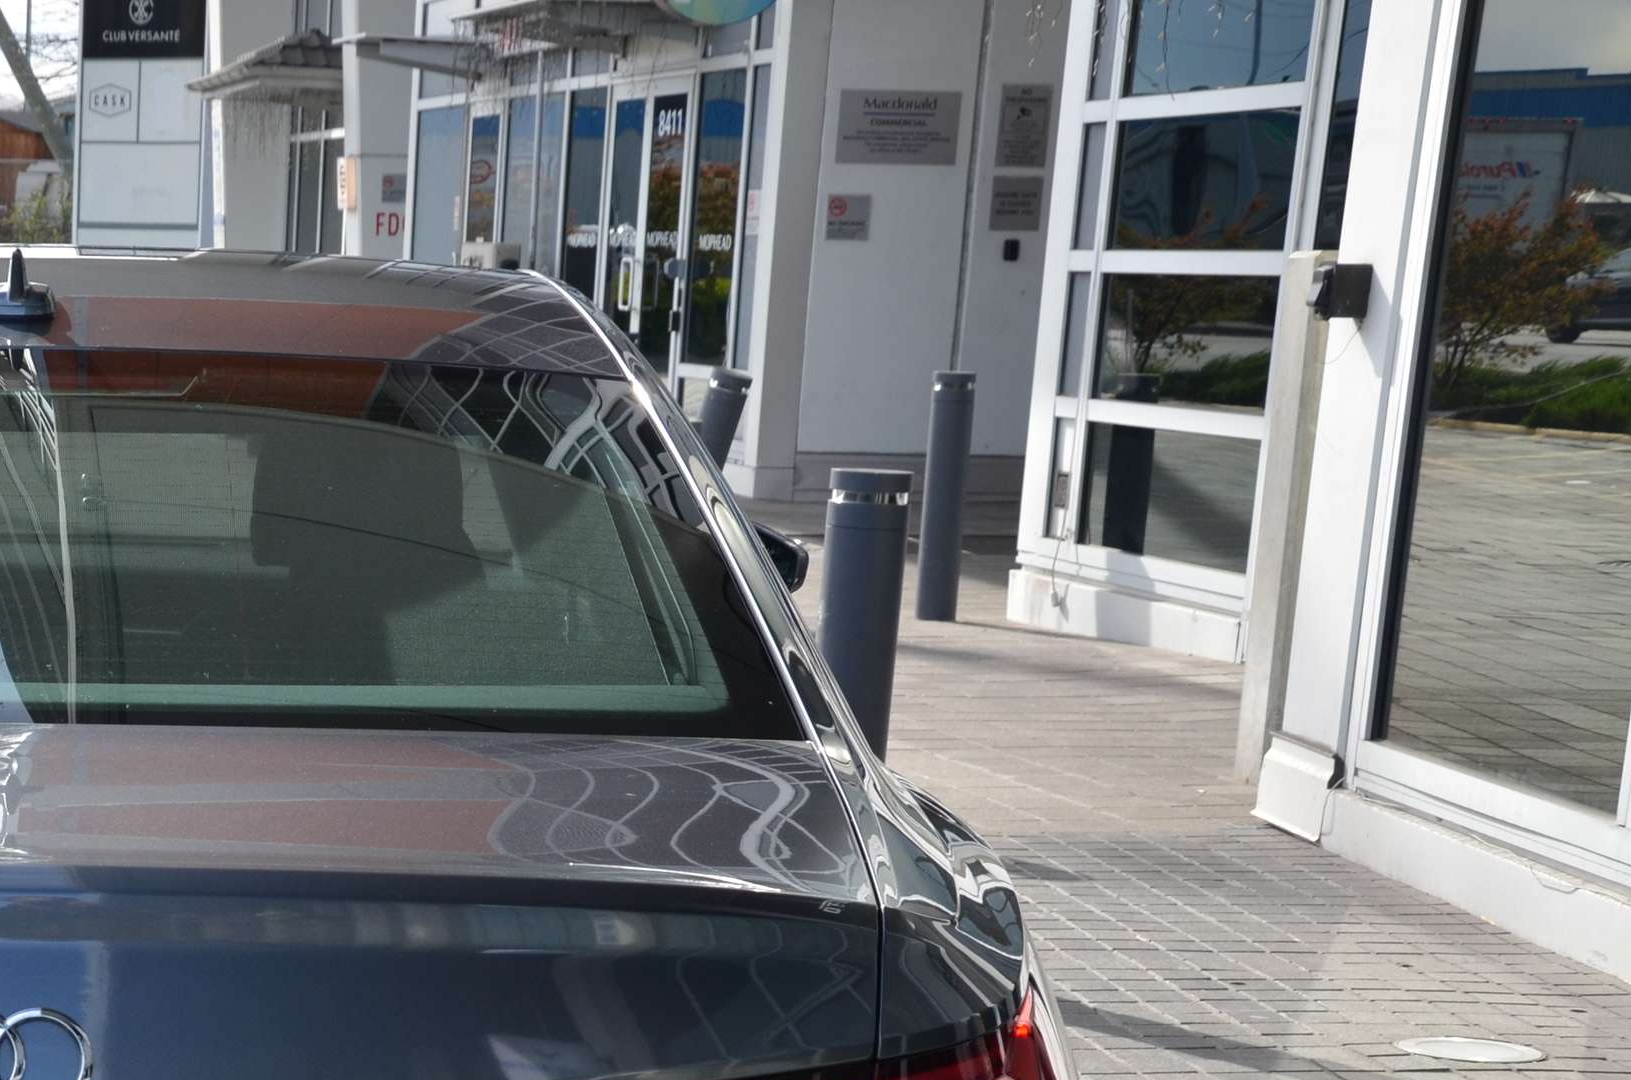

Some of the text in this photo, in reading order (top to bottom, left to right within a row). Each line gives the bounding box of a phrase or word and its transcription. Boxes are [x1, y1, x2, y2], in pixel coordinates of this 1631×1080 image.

[102, 29, 127, 42] CLUB
[94, 94, 125, 106] CASK
[863, 96, 939, 111] Macdonald
[658, 108, 683, 138] 8411
[376, 212, 406, 236] FD
[698, 233, 732, 251] MOPHEAD
